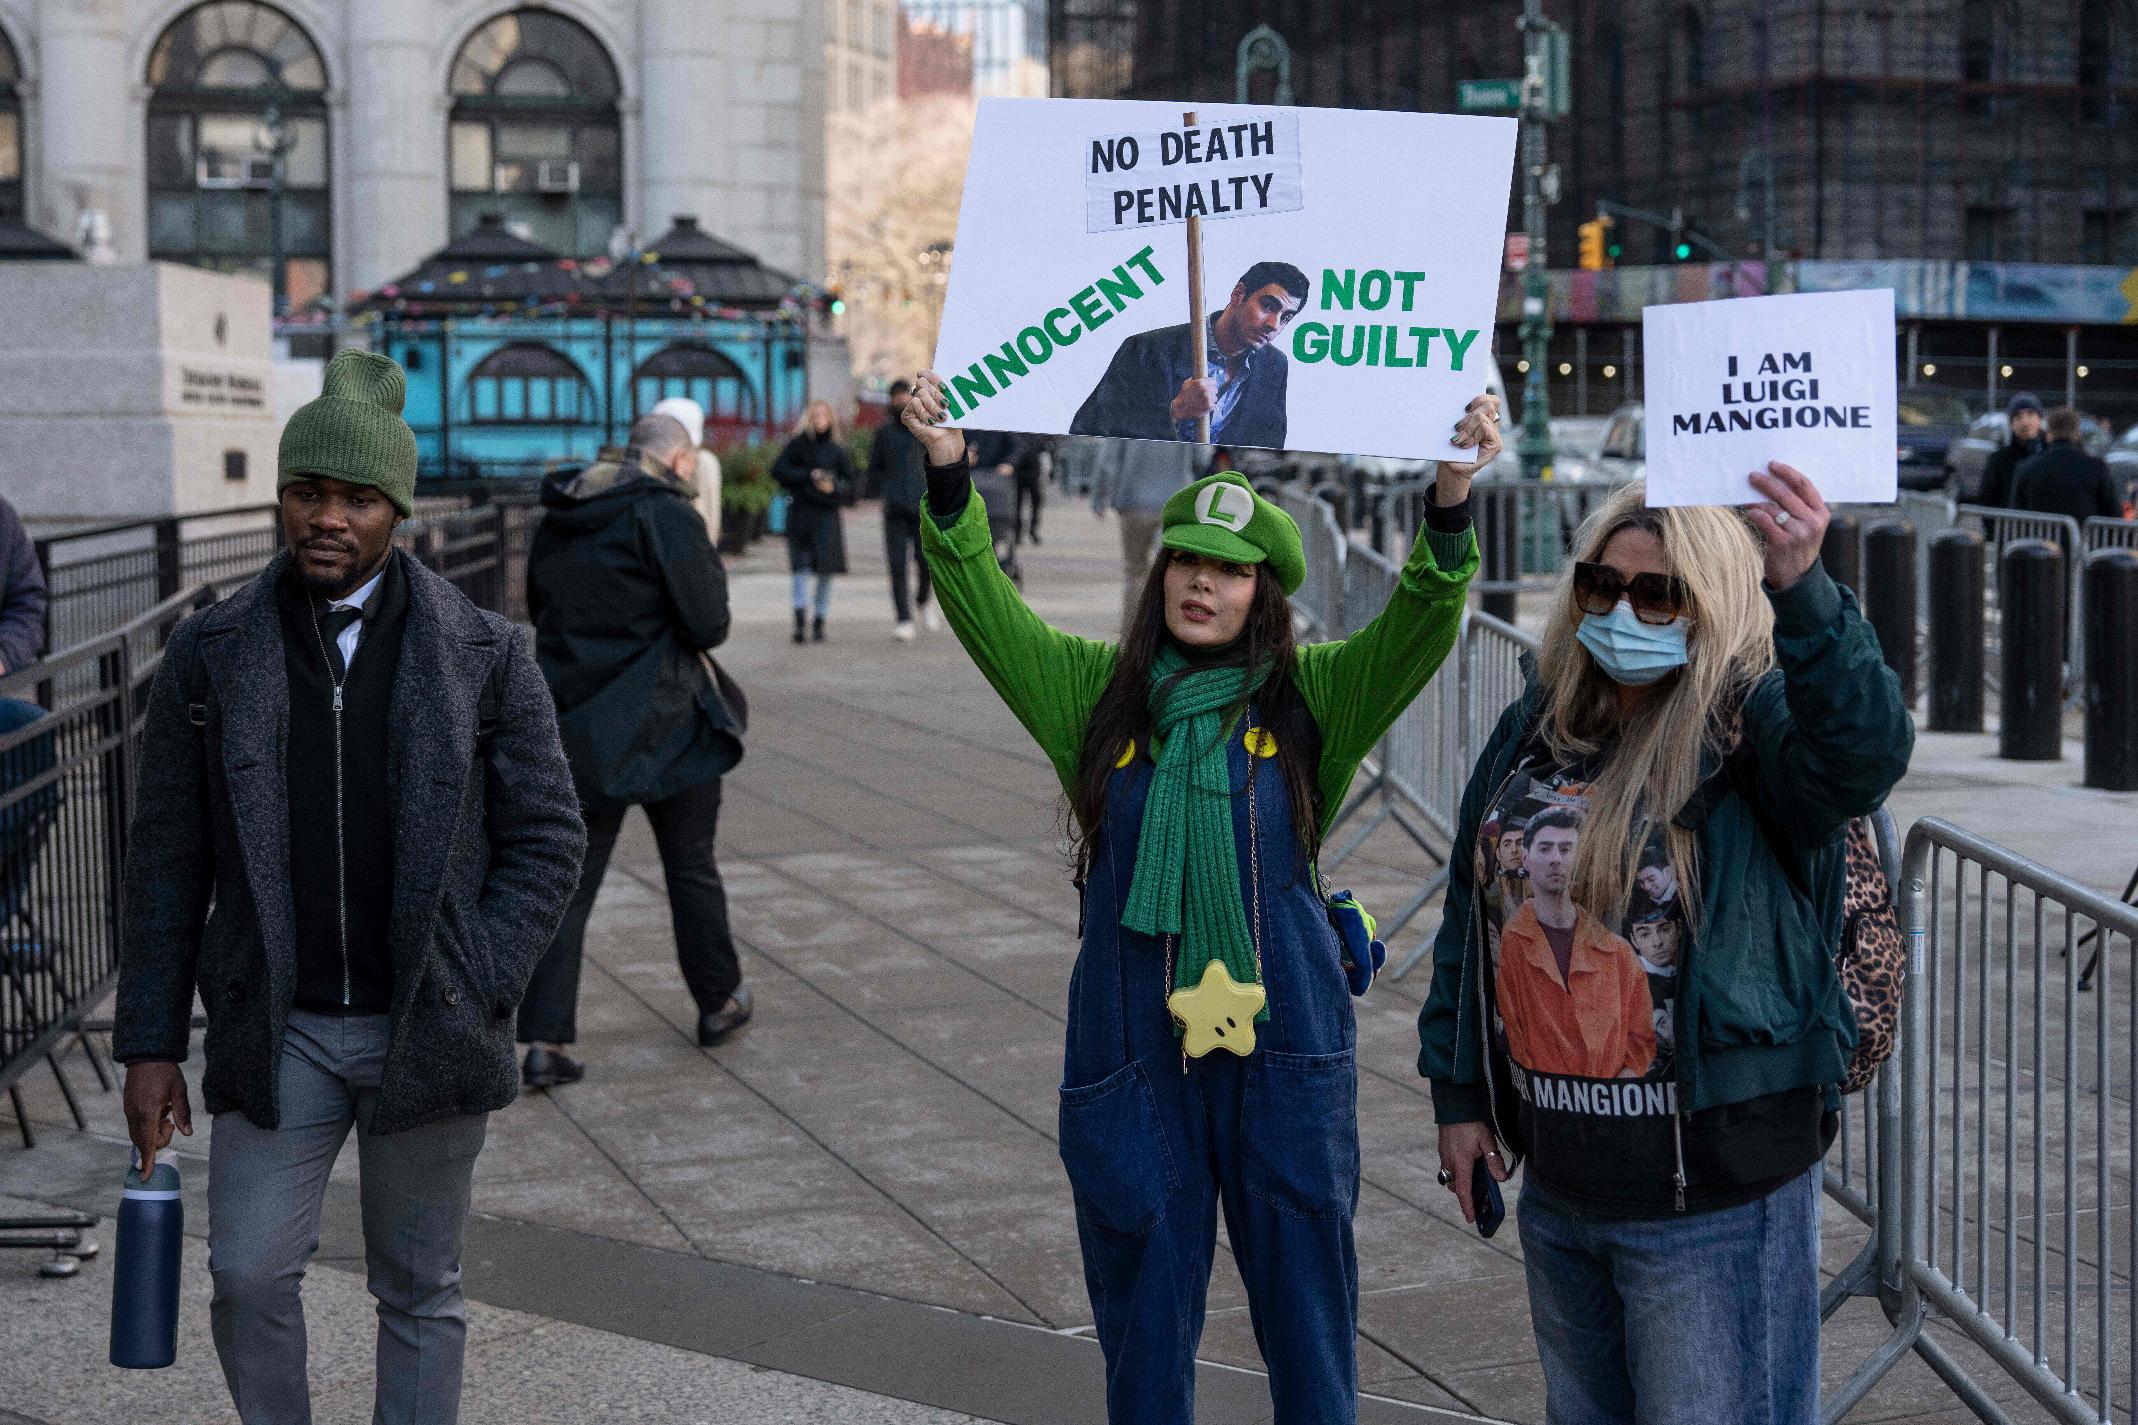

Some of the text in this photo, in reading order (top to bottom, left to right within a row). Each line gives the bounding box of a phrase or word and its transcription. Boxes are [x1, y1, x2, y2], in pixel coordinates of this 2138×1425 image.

[1092, 121, 1274, 173] NO DEATH
[1114, 173, 1273, 224] PENALTY
[1320, 269, 1426, 311] NOT
[941, 245, 1165, 421] INNOCENT
[1292, 321, 1480, 371] GUILTY
[1728, 352, 1812, 377] I AM
[1722, 379, 1819, 405] LUIGI
[1673, 406, 1872, 436] MANGIONE
[1207, 486, 1235, 524] L
